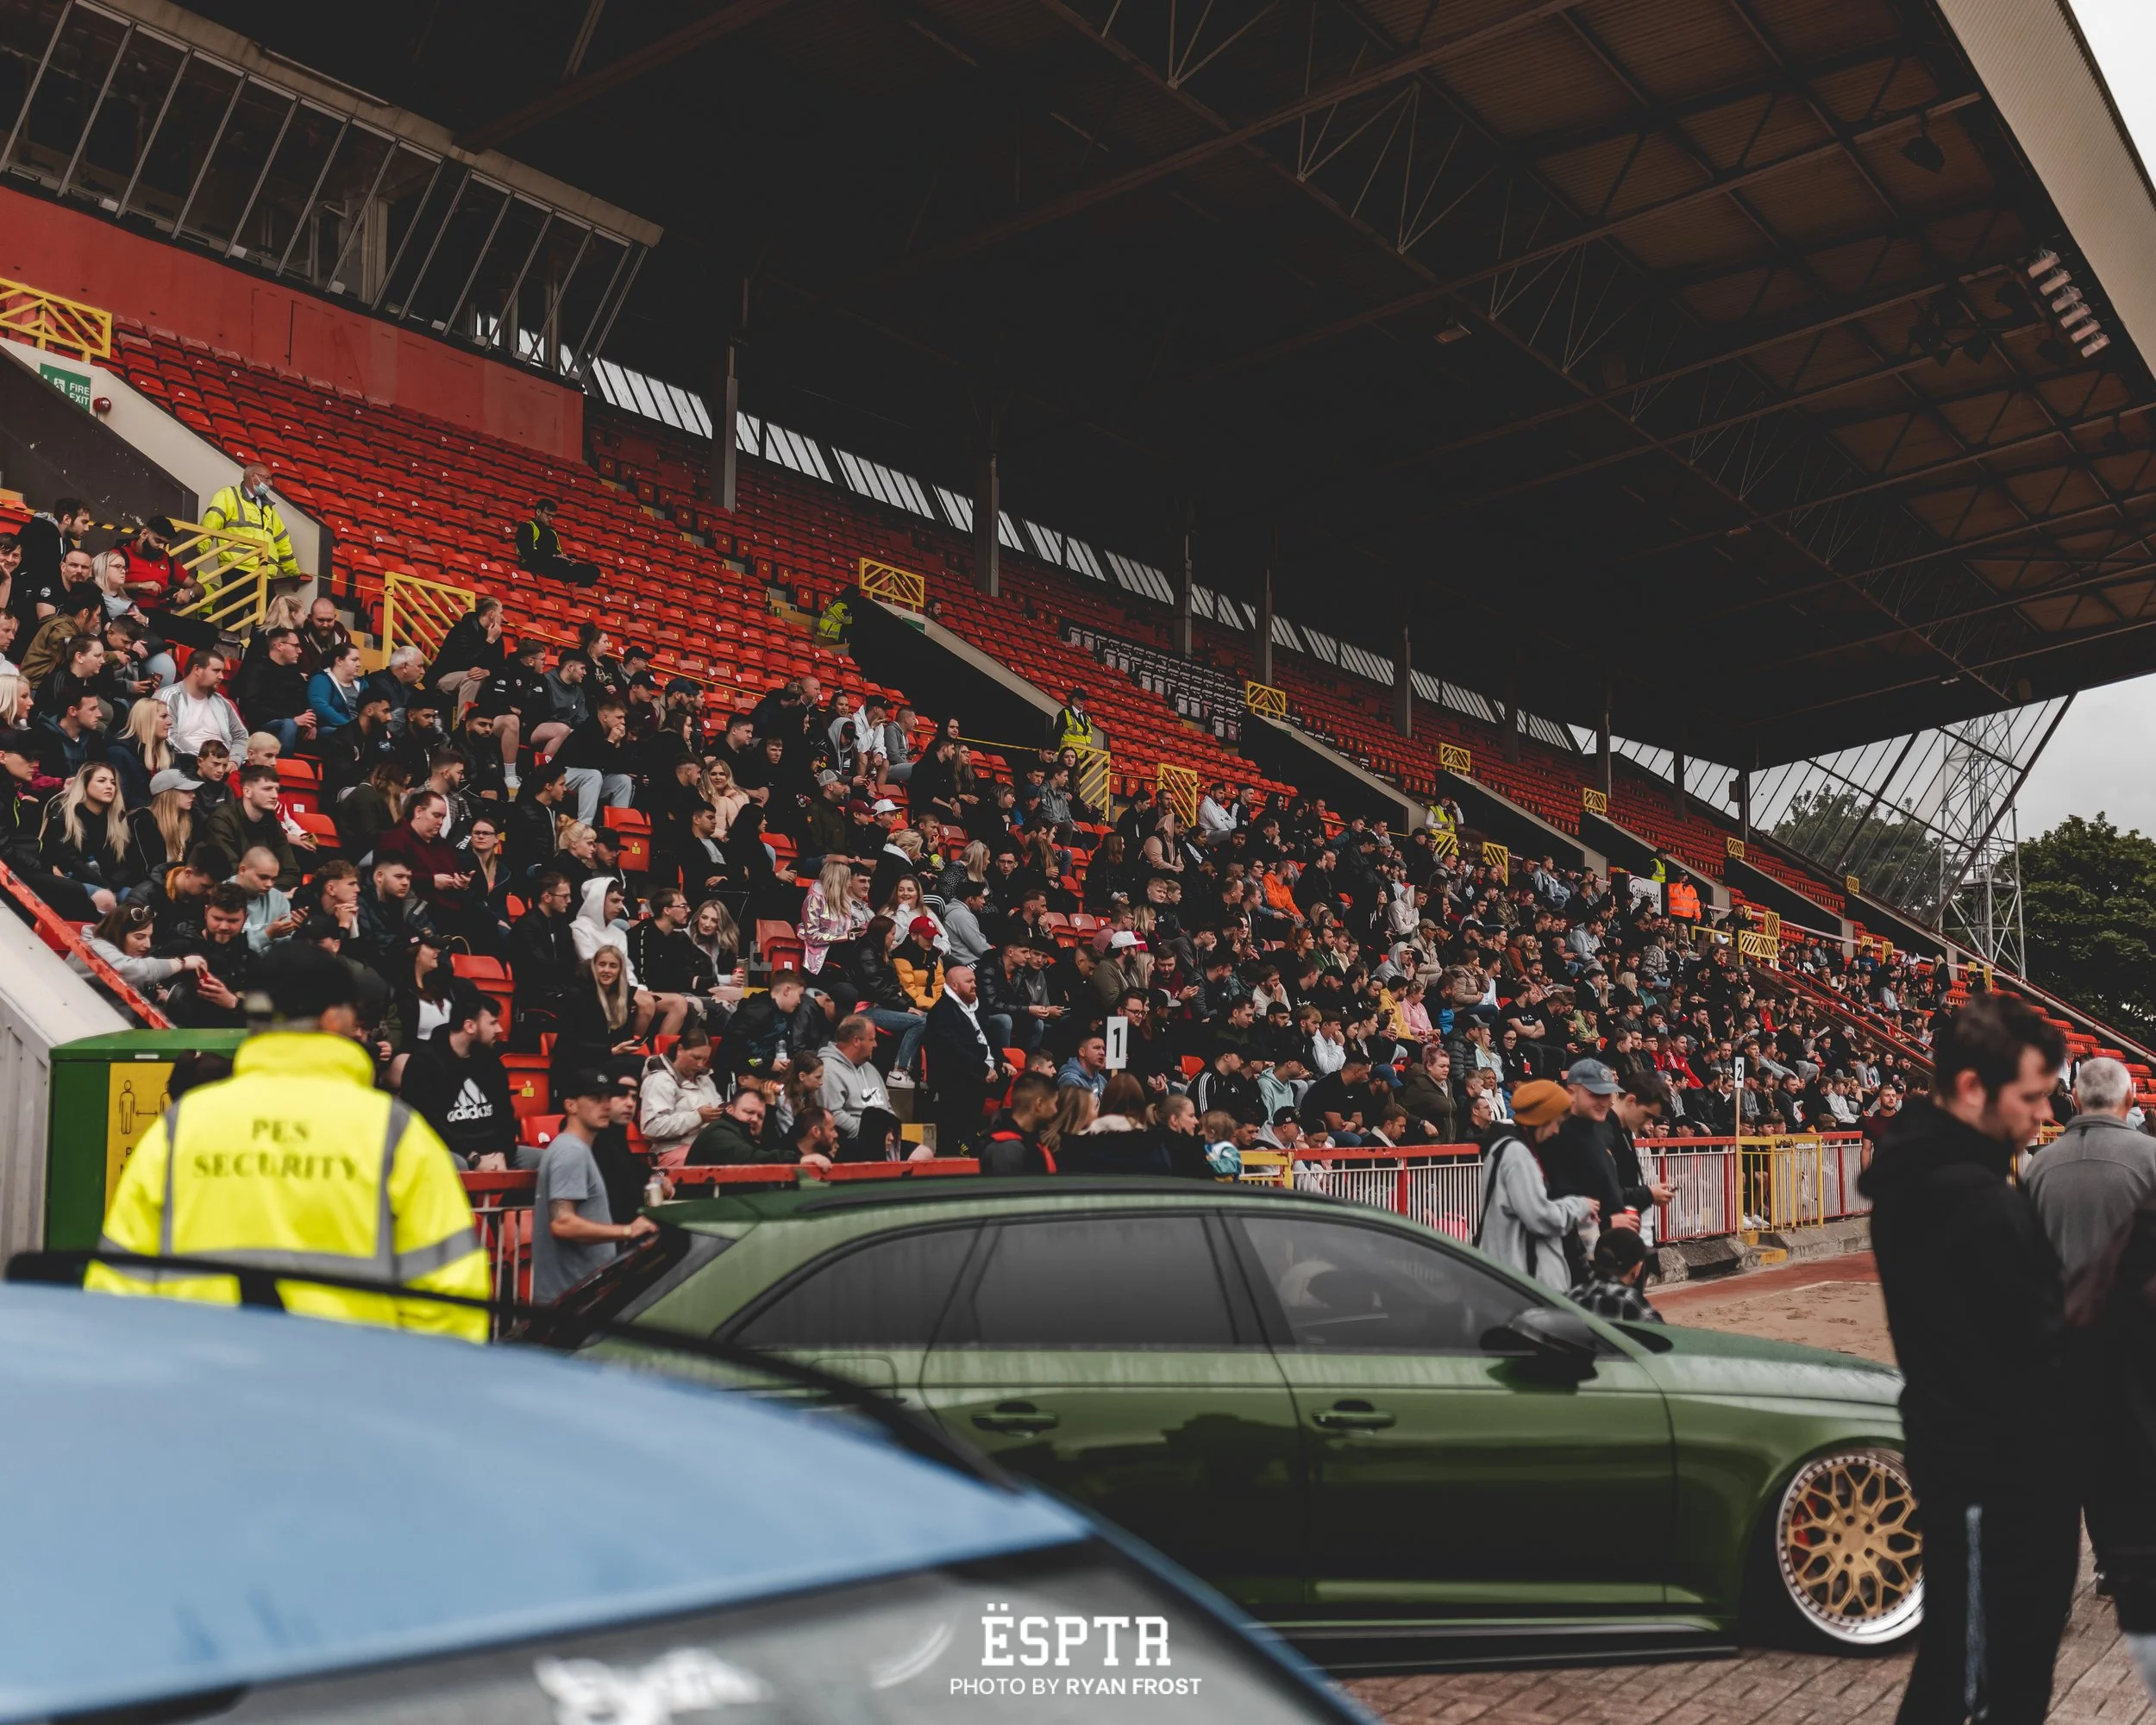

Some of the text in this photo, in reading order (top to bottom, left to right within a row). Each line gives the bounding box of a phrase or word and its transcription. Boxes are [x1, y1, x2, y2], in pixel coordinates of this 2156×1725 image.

[69, 382, 90, 396] FIRE
[69, 392, 90, 405] EXIT
[1112, 1027, 1121, 1058] 1
[1737, 1063, 1743, 1082] 2
[447, 1103, 493, 1122] adidas
[251, 1118, 309, 1142] PES
[192, 1152, 357, 1181] SECURITY
